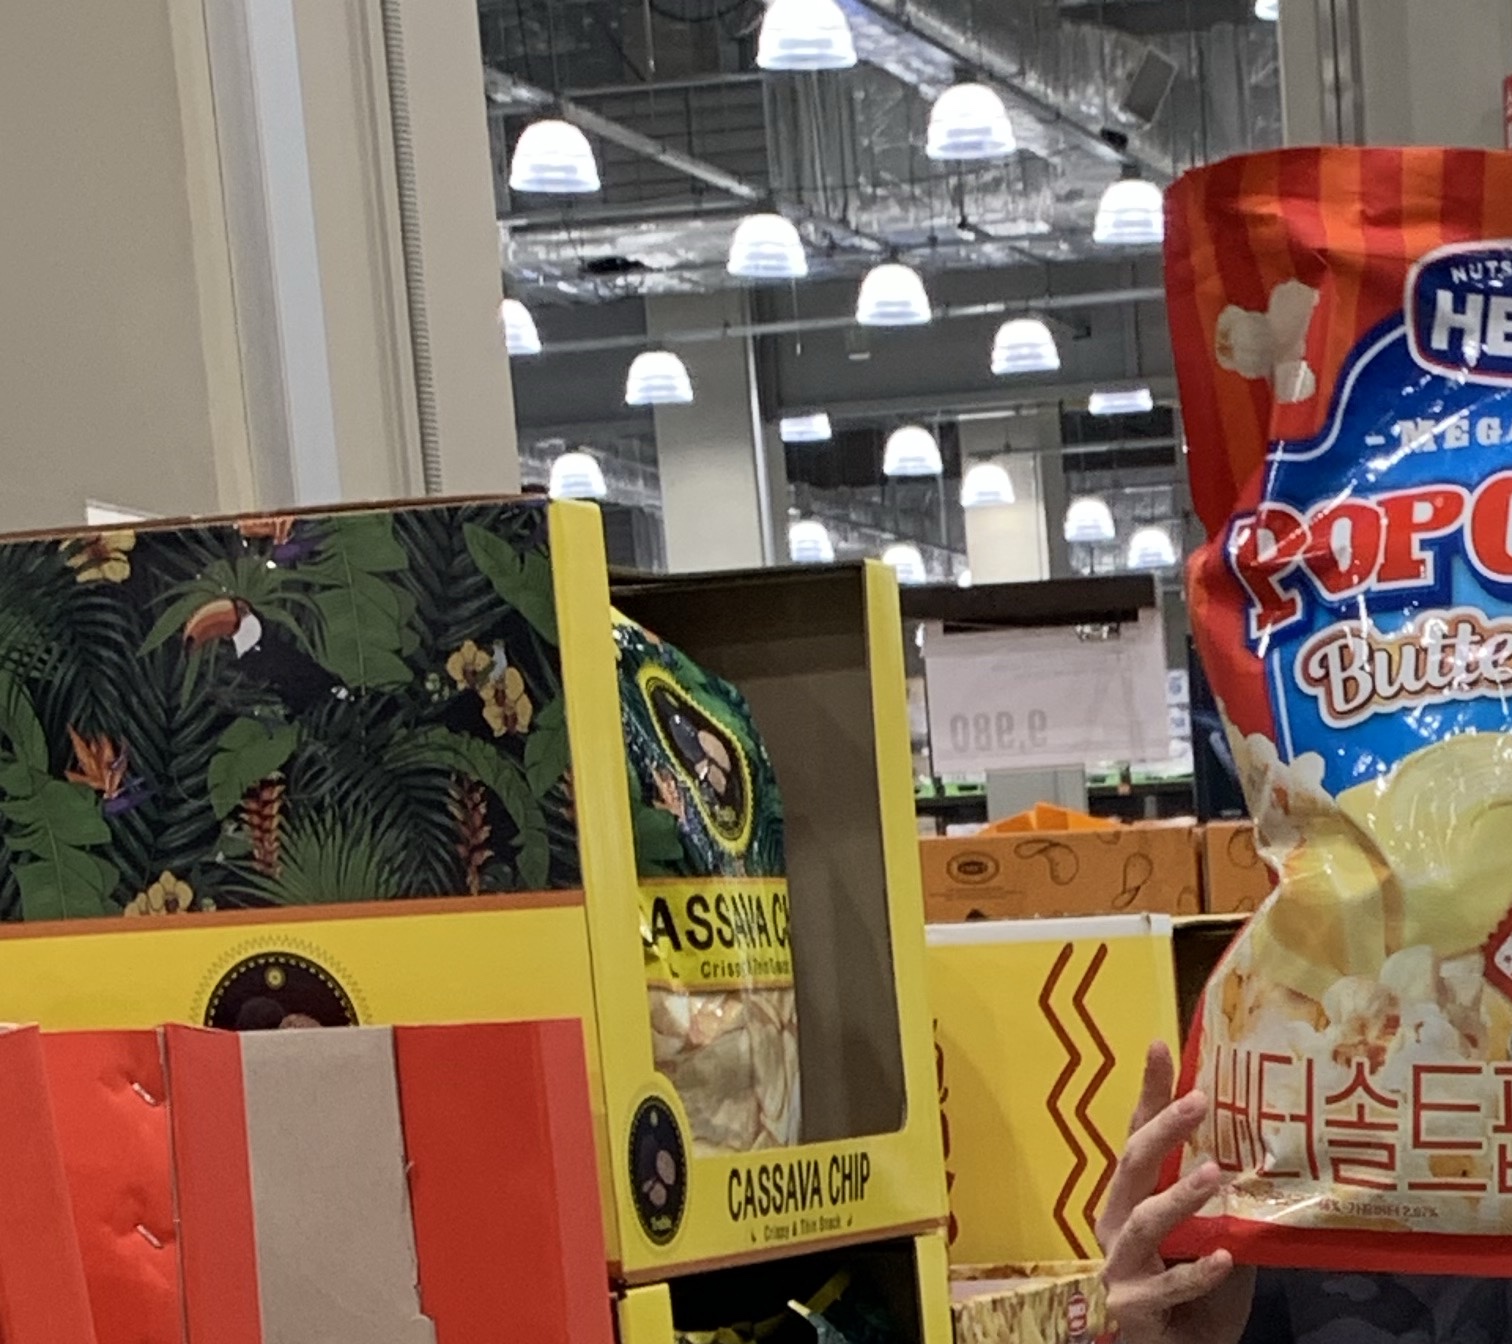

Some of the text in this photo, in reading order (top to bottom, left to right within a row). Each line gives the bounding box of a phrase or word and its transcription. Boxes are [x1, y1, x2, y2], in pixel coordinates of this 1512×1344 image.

[642, 890, 772, 952] ASSAVA
[728, 1151, 871, 1223] CASSAVA CHIP
